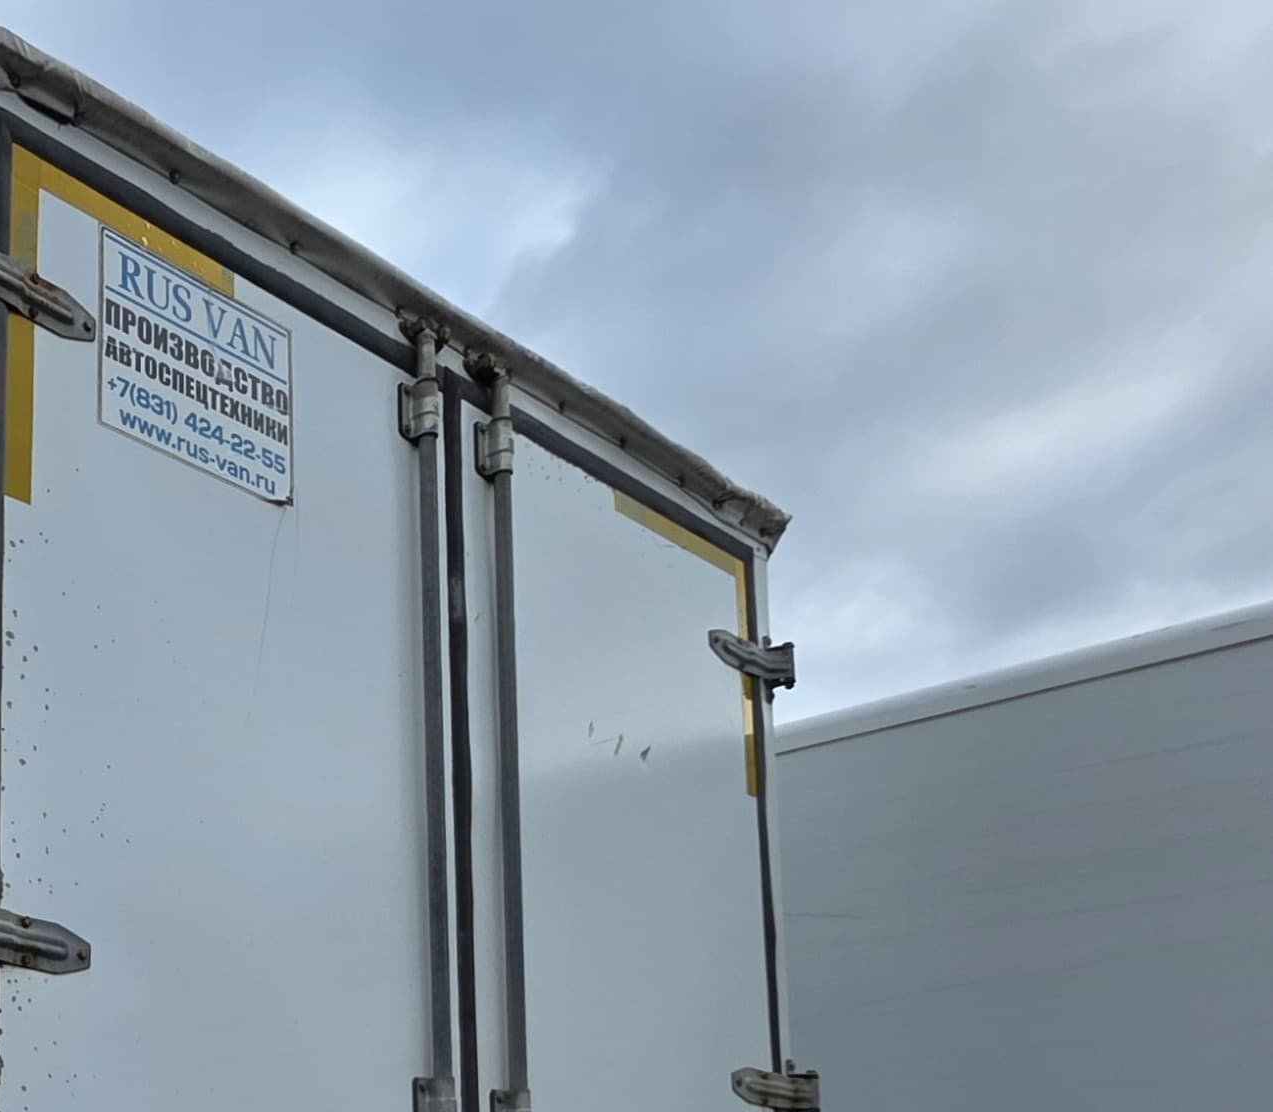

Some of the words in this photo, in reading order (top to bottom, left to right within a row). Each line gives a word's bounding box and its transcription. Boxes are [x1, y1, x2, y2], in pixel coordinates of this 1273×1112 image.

[105, 298, 290, 417] ПРОИЗВОДСТВО
[117, 251, 193, 323] RUS
[201, 297, 278, 371] VAN
[104, 335, 289, 447] АВТОСПЕЦТЕХНИКИ
[107, 376, 179, 426] +7(831)
[184, 412, 287, 475] 424-22-55
[119, 409, 276, 496] www.rus-van.ru
